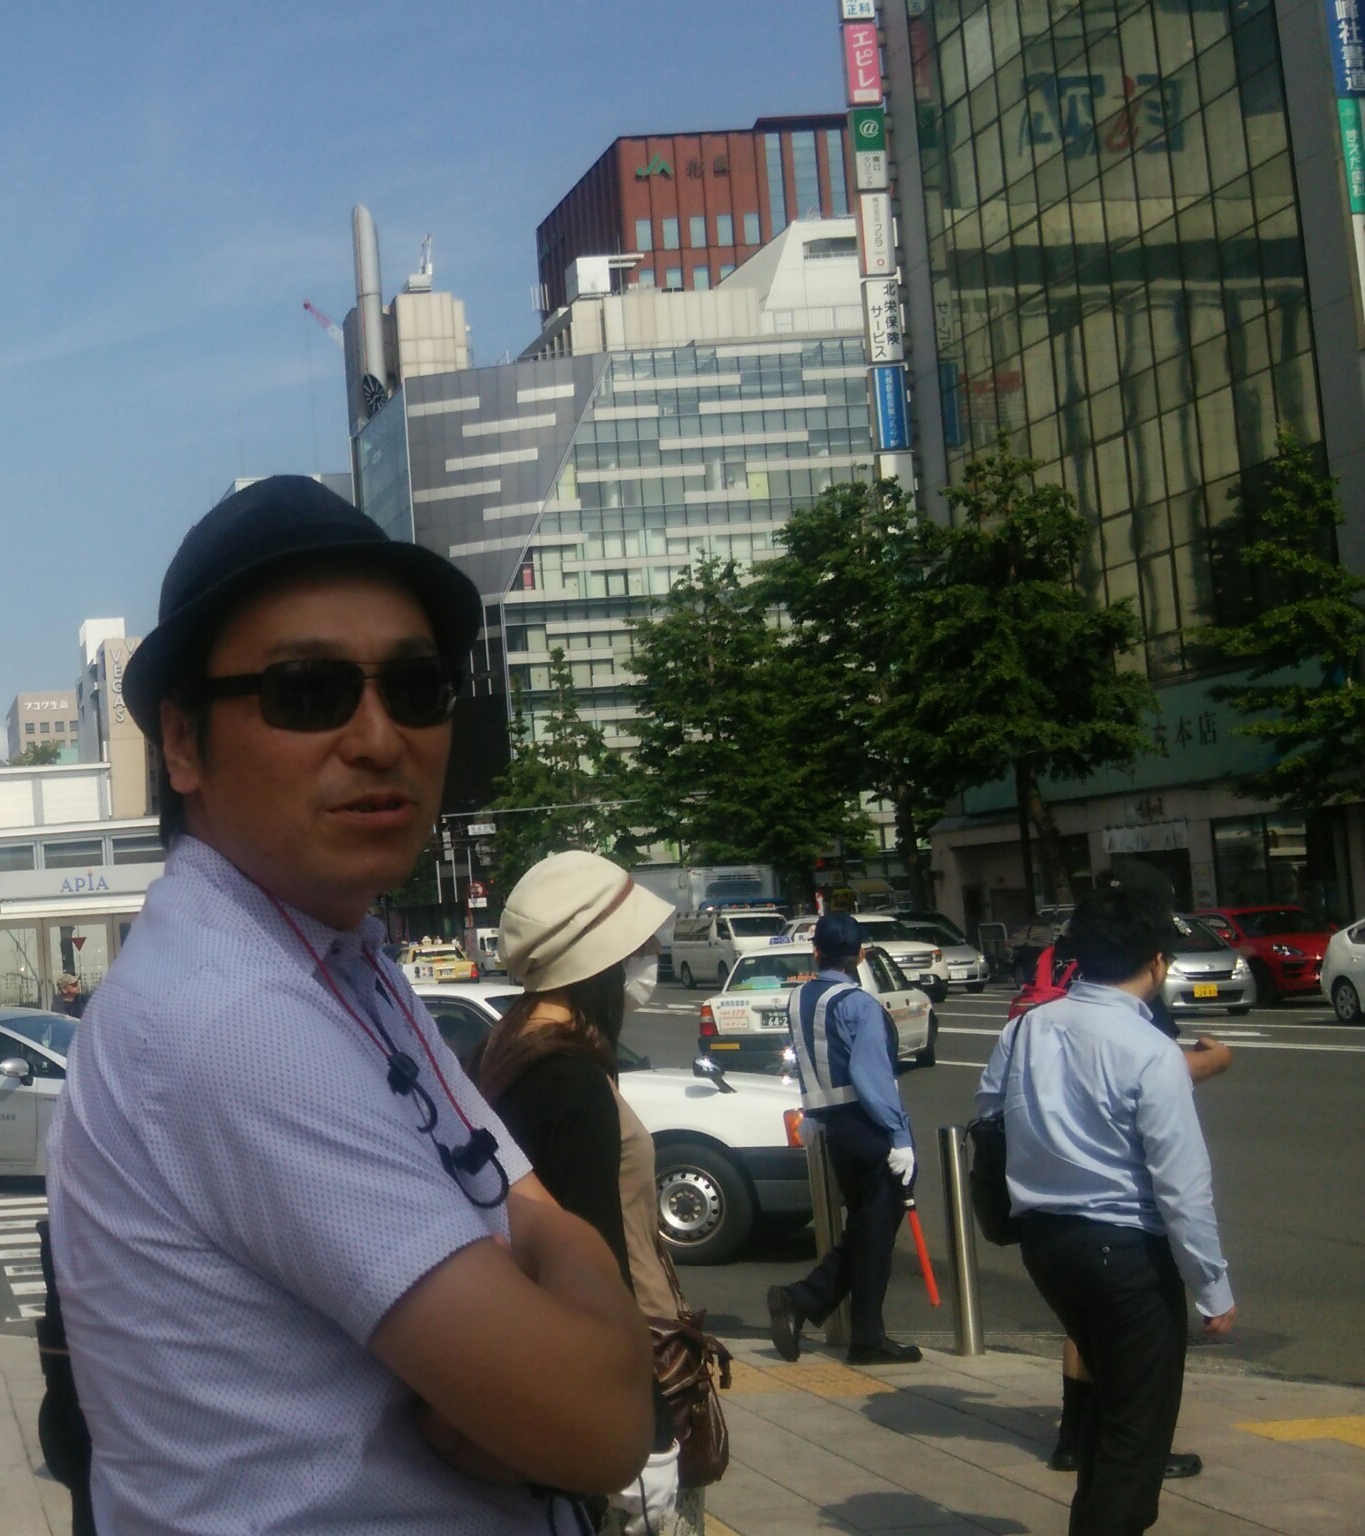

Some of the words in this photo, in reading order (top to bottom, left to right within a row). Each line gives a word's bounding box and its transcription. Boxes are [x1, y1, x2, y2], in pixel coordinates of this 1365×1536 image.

[852, 31, 875, 88] エピレ
[871, 305, 887, 358] サービス
[883, 283, 900, 345] 北栄保険
[23, 700, 69, 711] フコク生命
[60, 869, 110, 892] APIA
